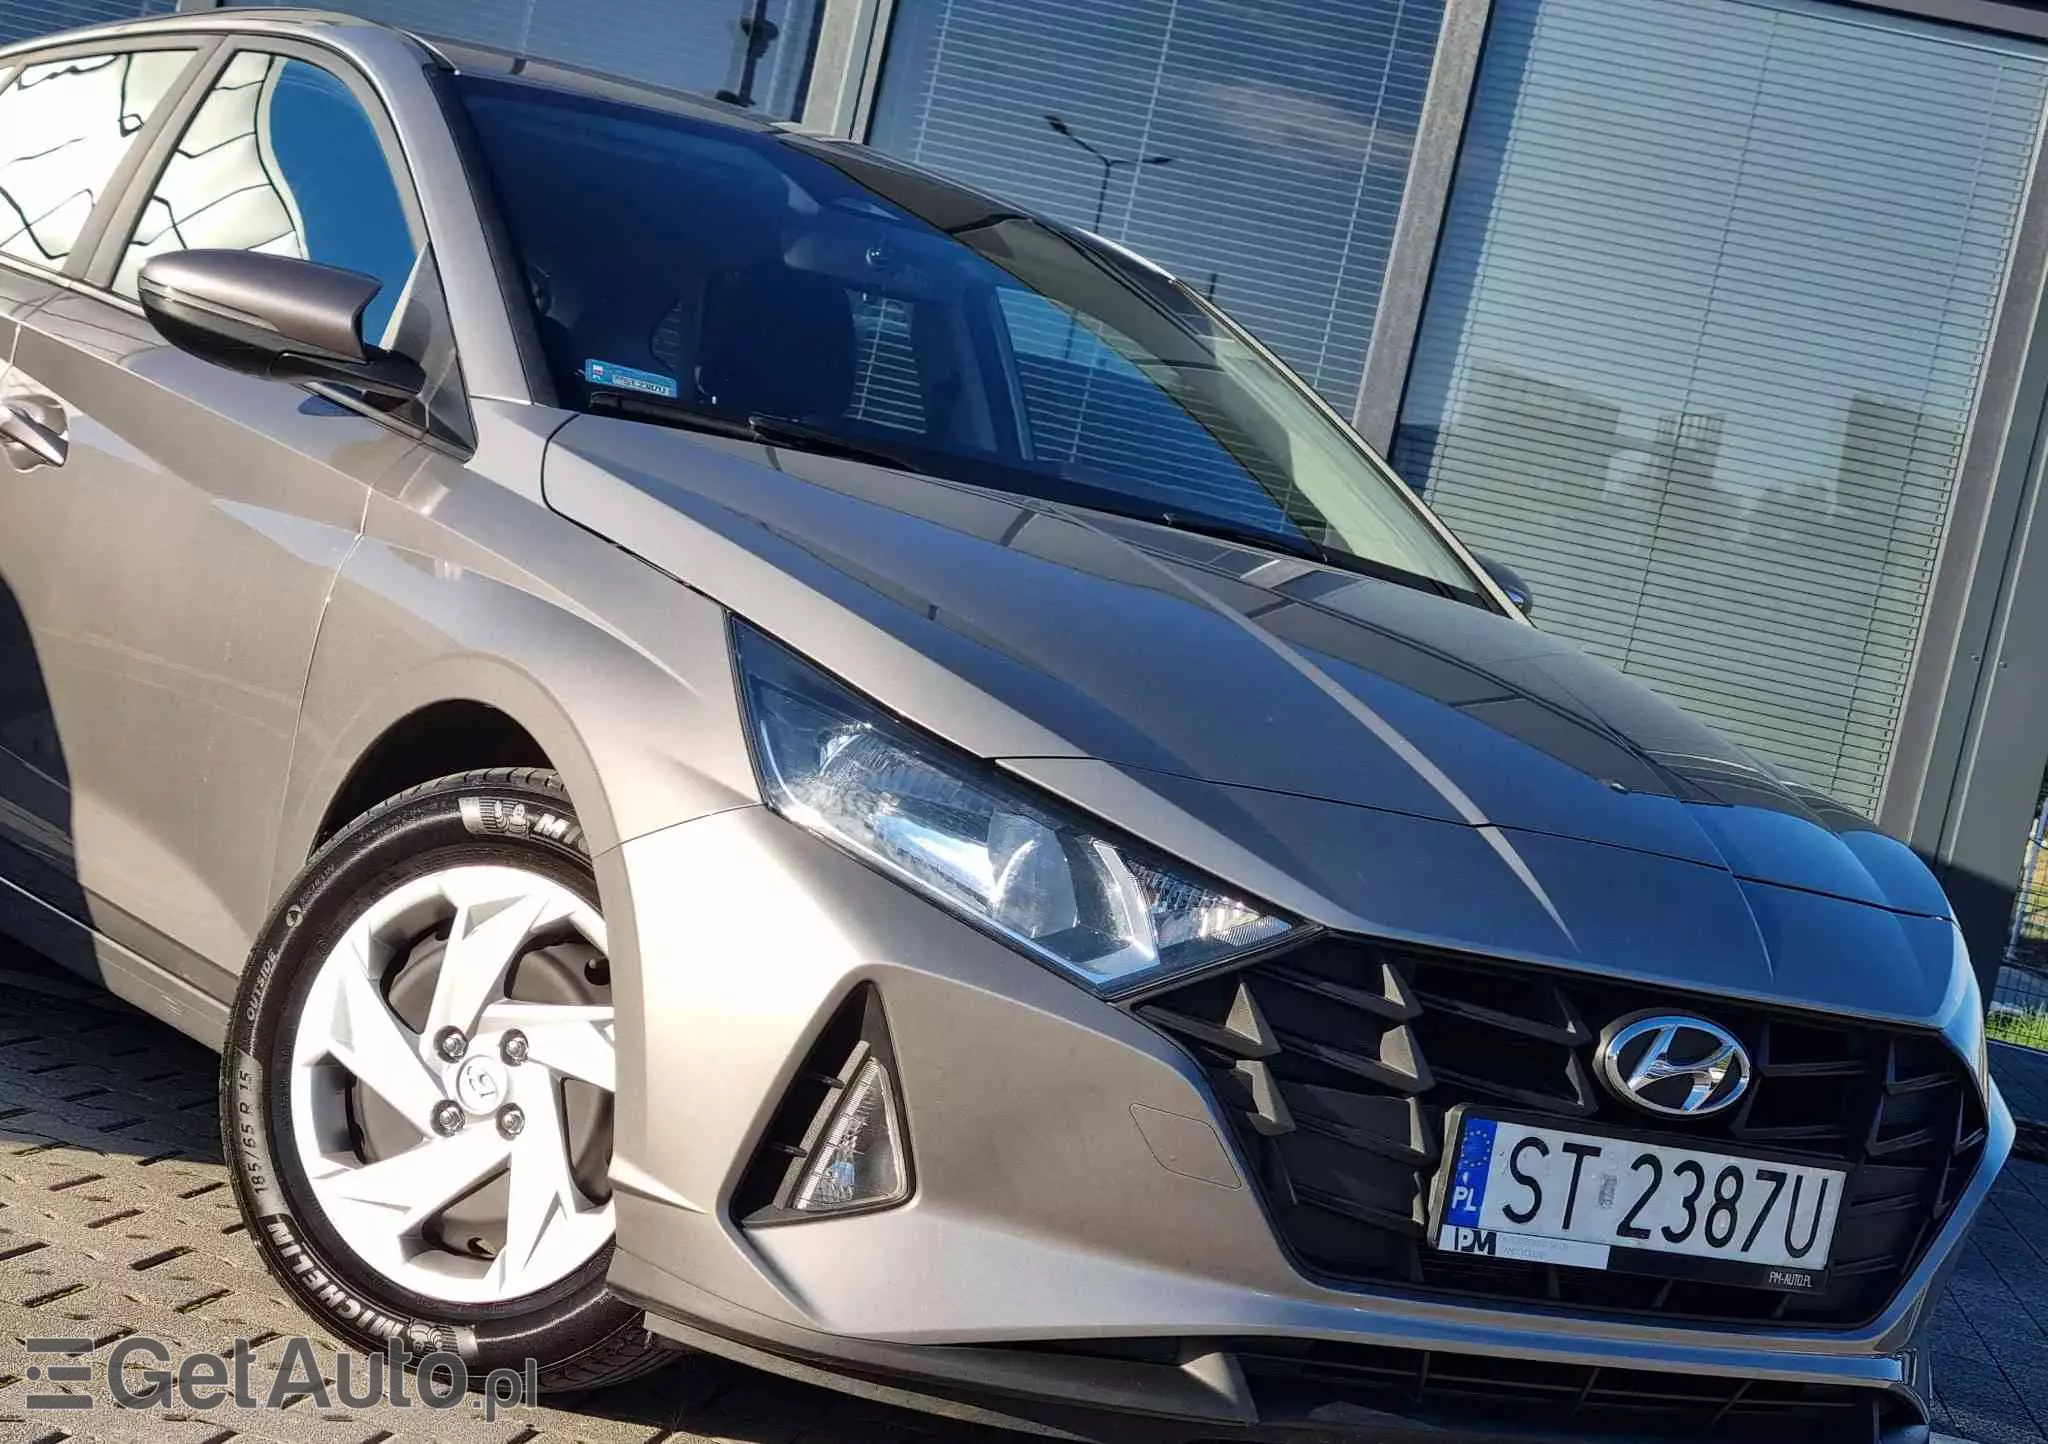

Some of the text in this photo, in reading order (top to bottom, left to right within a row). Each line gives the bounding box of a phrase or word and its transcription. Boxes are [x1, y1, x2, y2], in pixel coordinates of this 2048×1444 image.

[247, 948, 277, 1021] OUTSIDE
[238, 1070, 266, 1195] 185/65 R 15
[1451, 1186, 1477, 1213] PL
[1502, 1136, 1829, 1259] ST 2387U
[266, 1222, 405, 1338] MICHELIN
